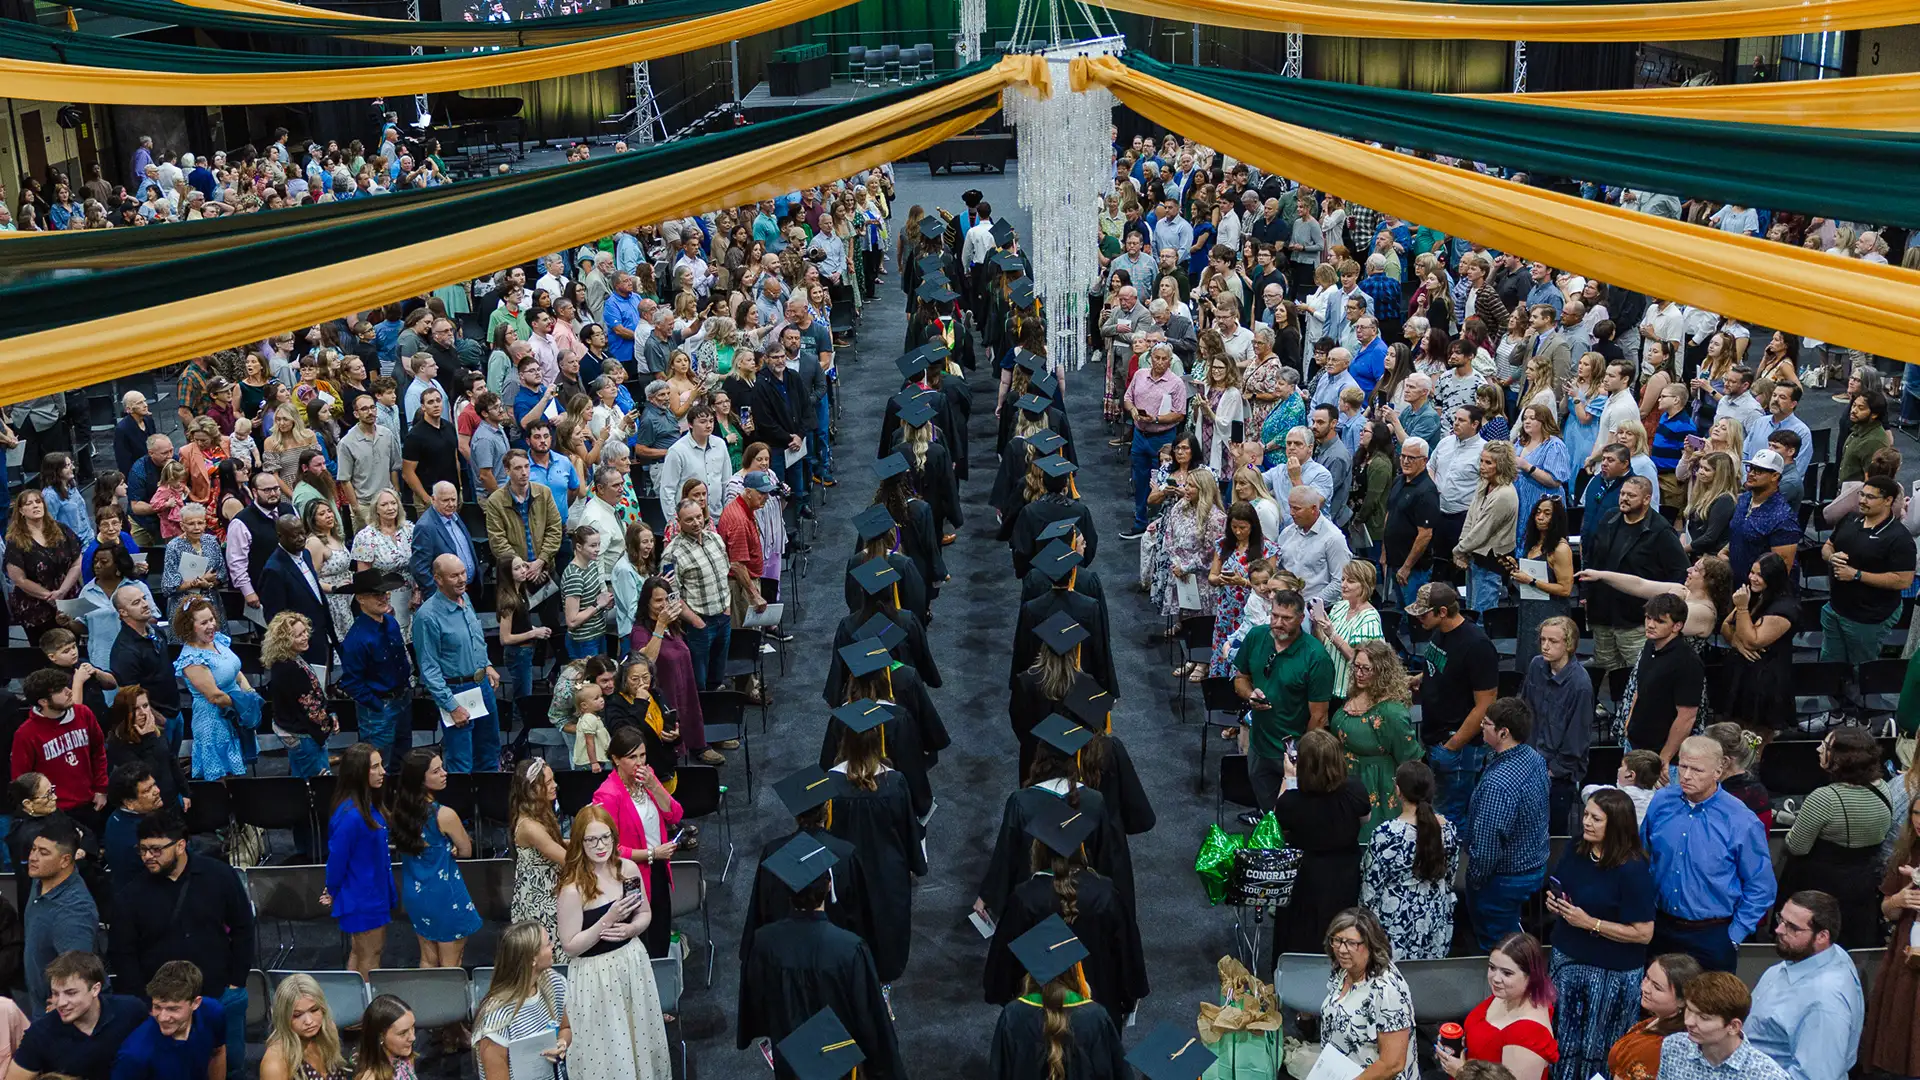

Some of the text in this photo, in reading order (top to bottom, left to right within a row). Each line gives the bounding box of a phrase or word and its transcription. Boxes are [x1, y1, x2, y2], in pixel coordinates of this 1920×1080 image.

[1871, 42, 1880, 66] 3
[1246, 869, 1298, 880] CONGRATS
[1244, 886, 1260, 894] YOU
[1265, 887, 1279, 895] DID
[1245, 897, 1289, 906] GRAD
